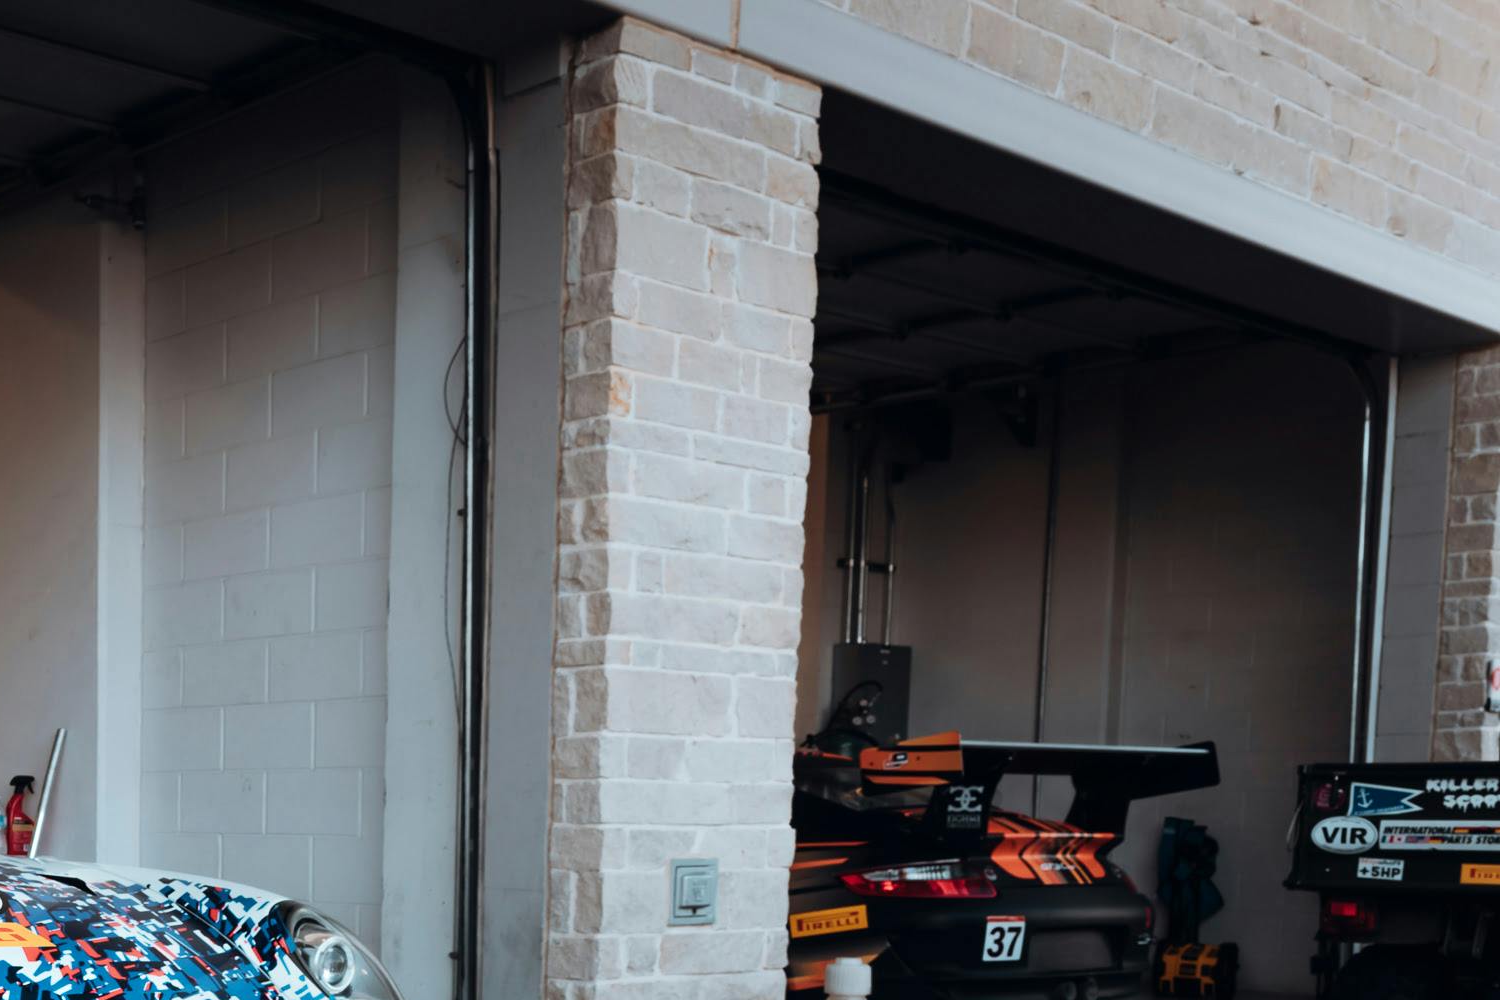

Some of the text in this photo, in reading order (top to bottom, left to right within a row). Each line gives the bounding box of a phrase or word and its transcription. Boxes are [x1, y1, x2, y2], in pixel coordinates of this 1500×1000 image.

[1425, 778, 1499, 793] KILLER
[1442, 794, 1500, 812] SCOO
[1321, 827, 1368, 845] VIR
[797, 911, 860, 932] PIRELLI
[986, 926, 1022, 958] 37
